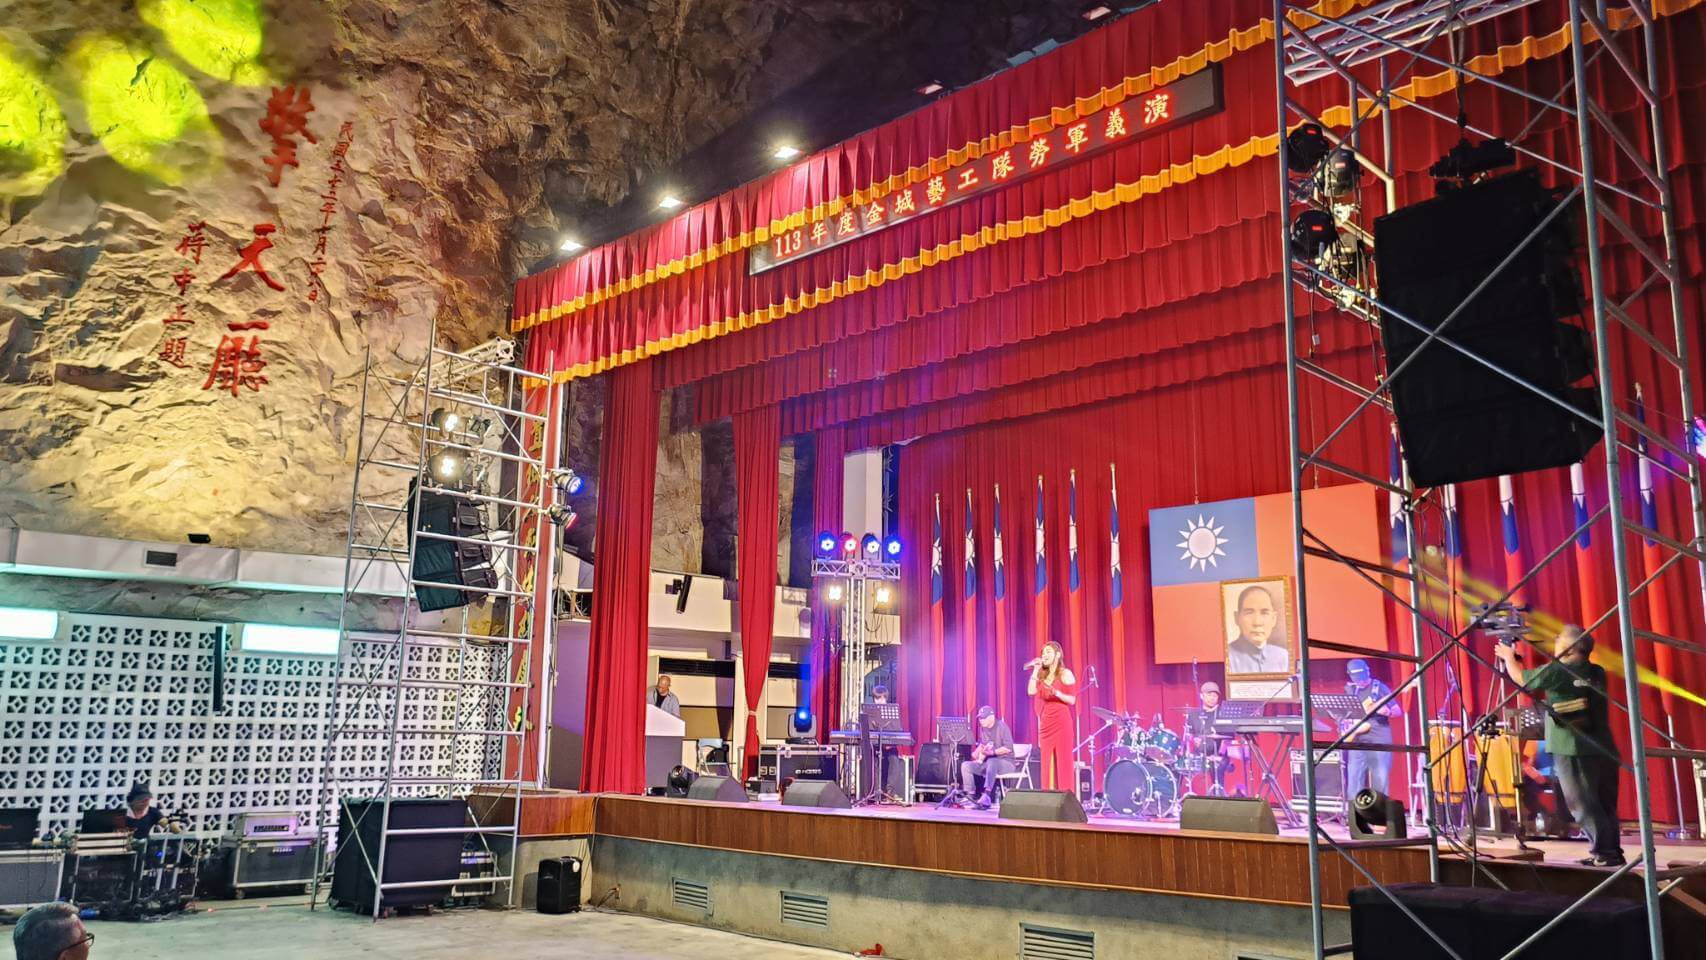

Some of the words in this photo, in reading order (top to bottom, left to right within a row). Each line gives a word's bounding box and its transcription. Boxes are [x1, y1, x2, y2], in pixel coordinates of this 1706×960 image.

[775, 93, 1169, 258] 113年度金城藝工隊勞軍義演
[158, 221, 210, 368] 蔣中正題
